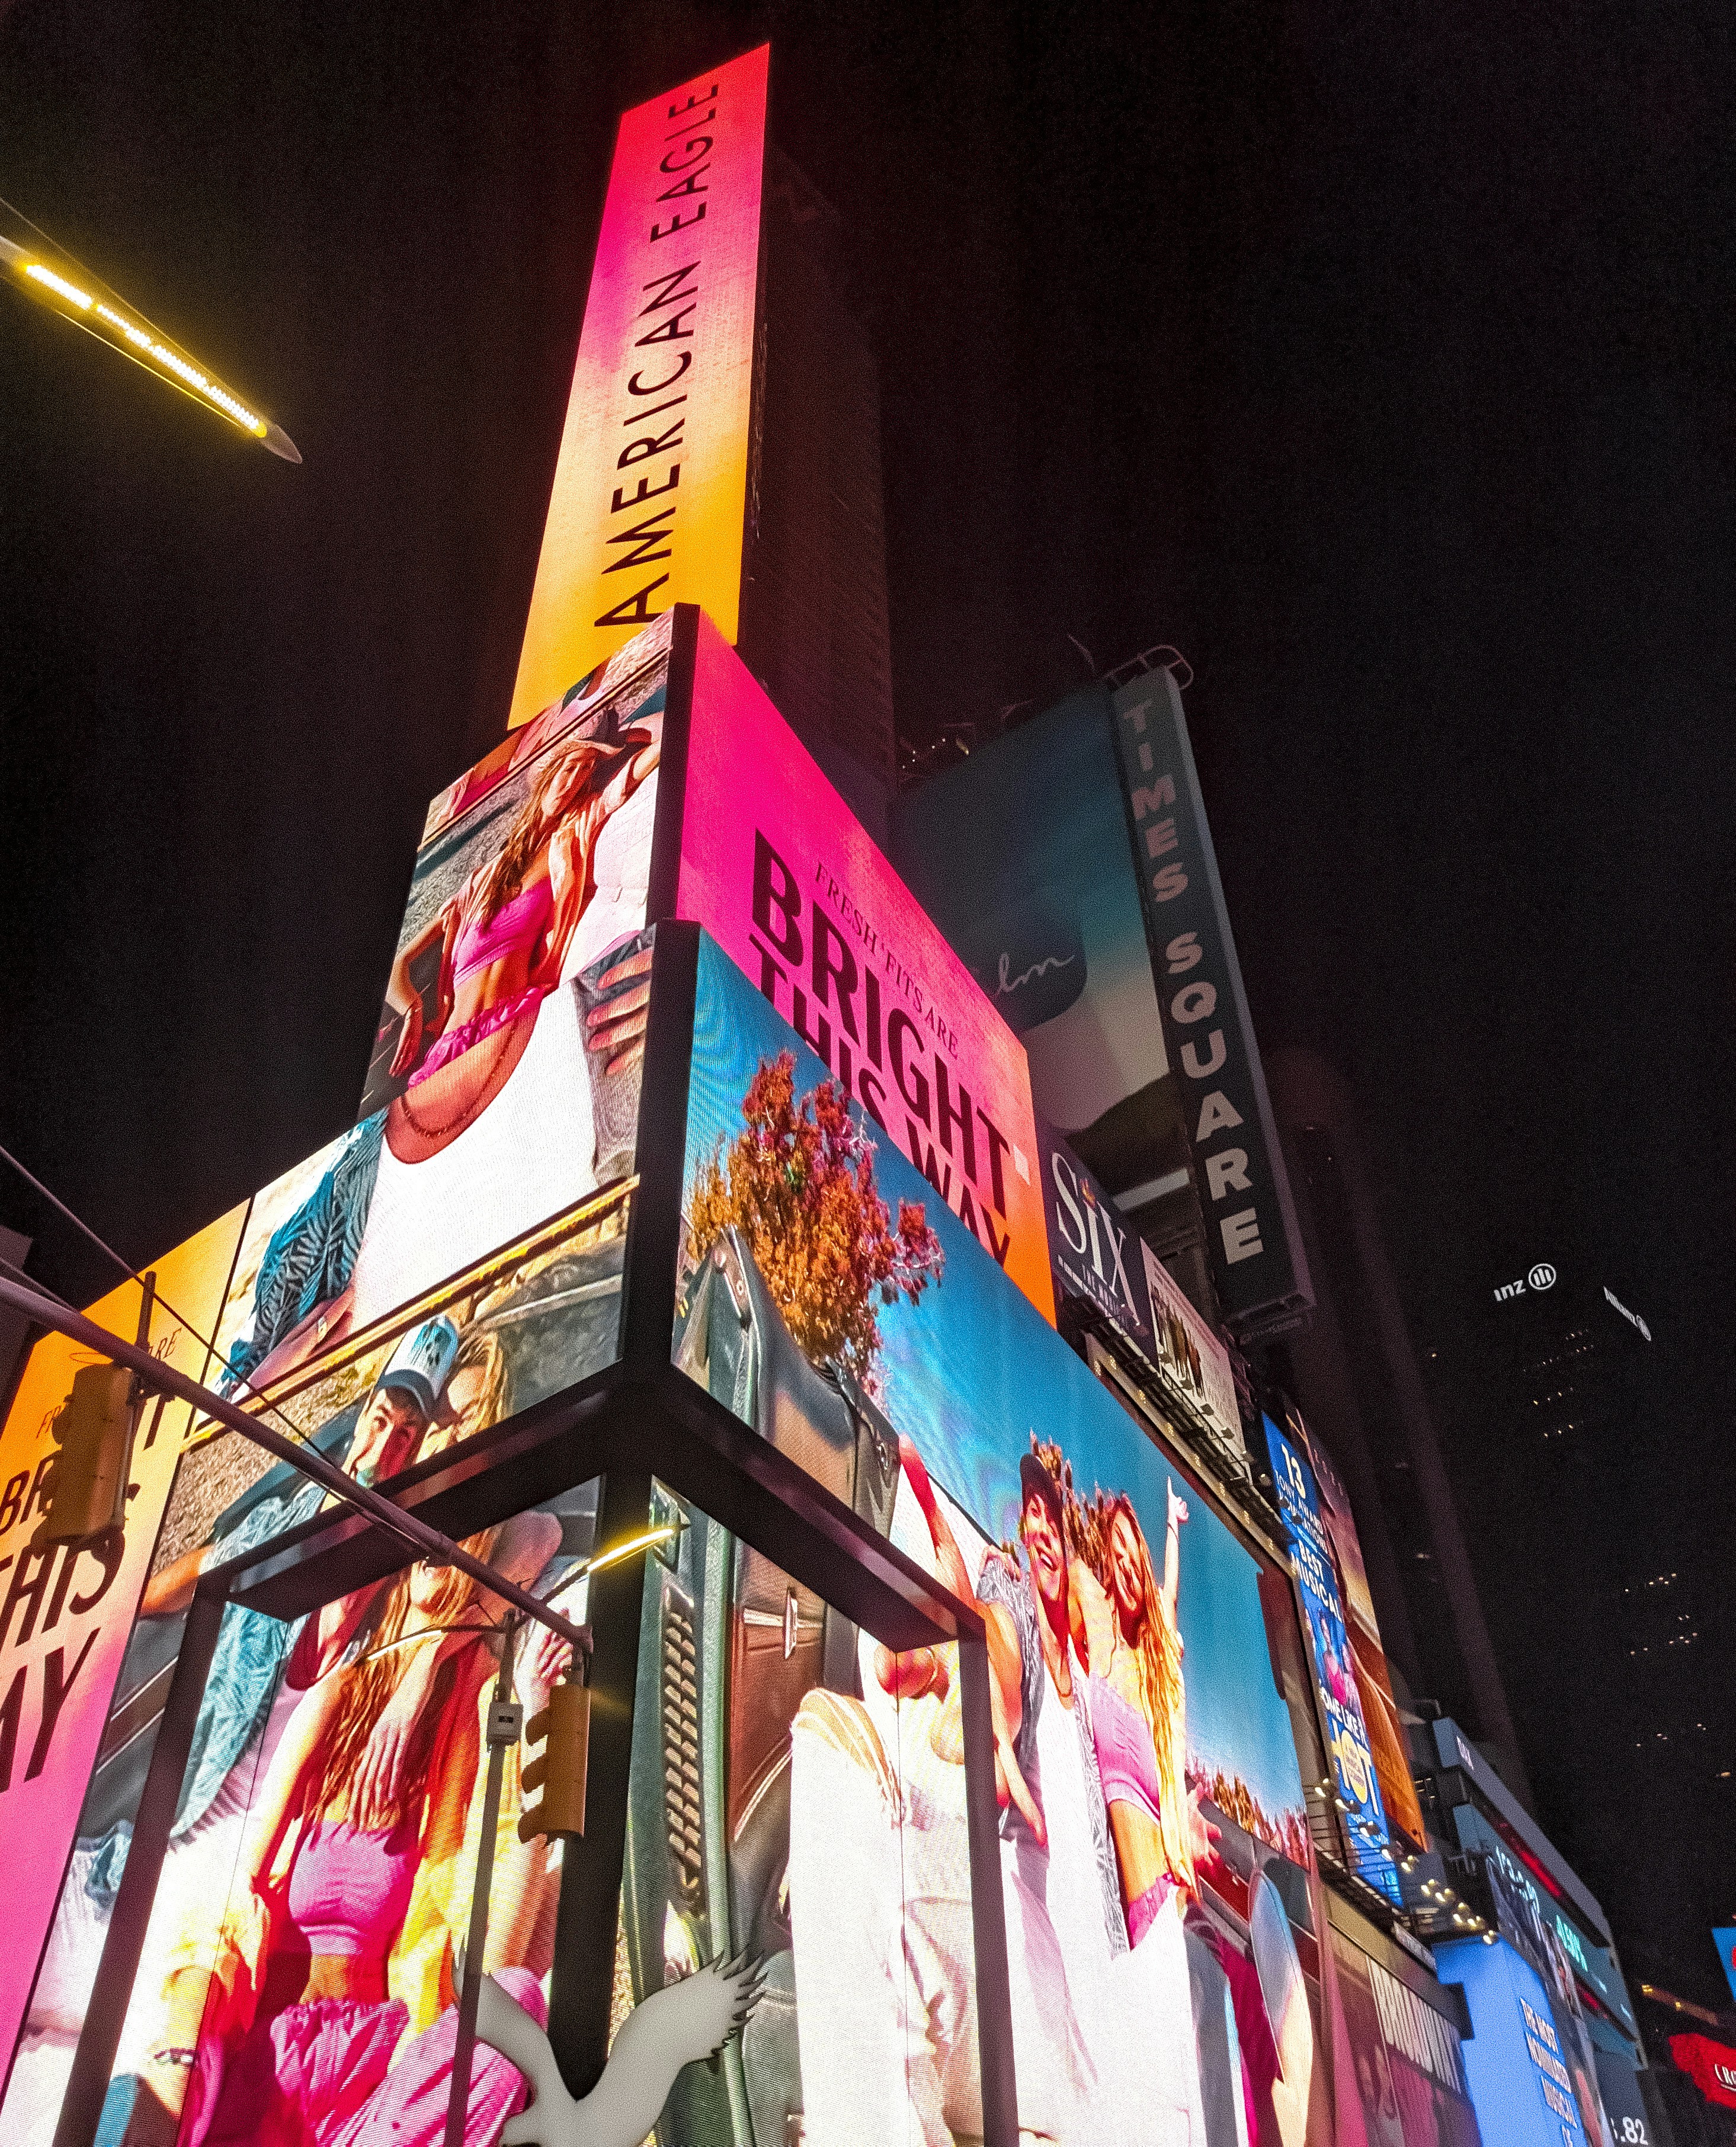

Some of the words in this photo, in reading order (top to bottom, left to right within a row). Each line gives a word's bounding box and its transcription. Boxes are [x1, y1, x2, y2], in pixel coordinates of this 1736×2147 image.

[594, 261, 702, 627] AMERICAN
[650, 83, 719, 242] EAGLE
[752, 828, 1010, 1218] BRIGHT
[816, 861, 878, 955] FRESH
[924, 1006, 959, 1060] ARE
[1123, 698, 1189, 902] TIMES
[1165, 932, 1263, 1265] SQUARE
[1051, 1152, 1139, 1326] SIX
[1281, 1443, 1306, 1499] 13
[1298, 1539, 1324, 1582] BEST
[1290, 1550, 1343, 1624] MUSICAL
